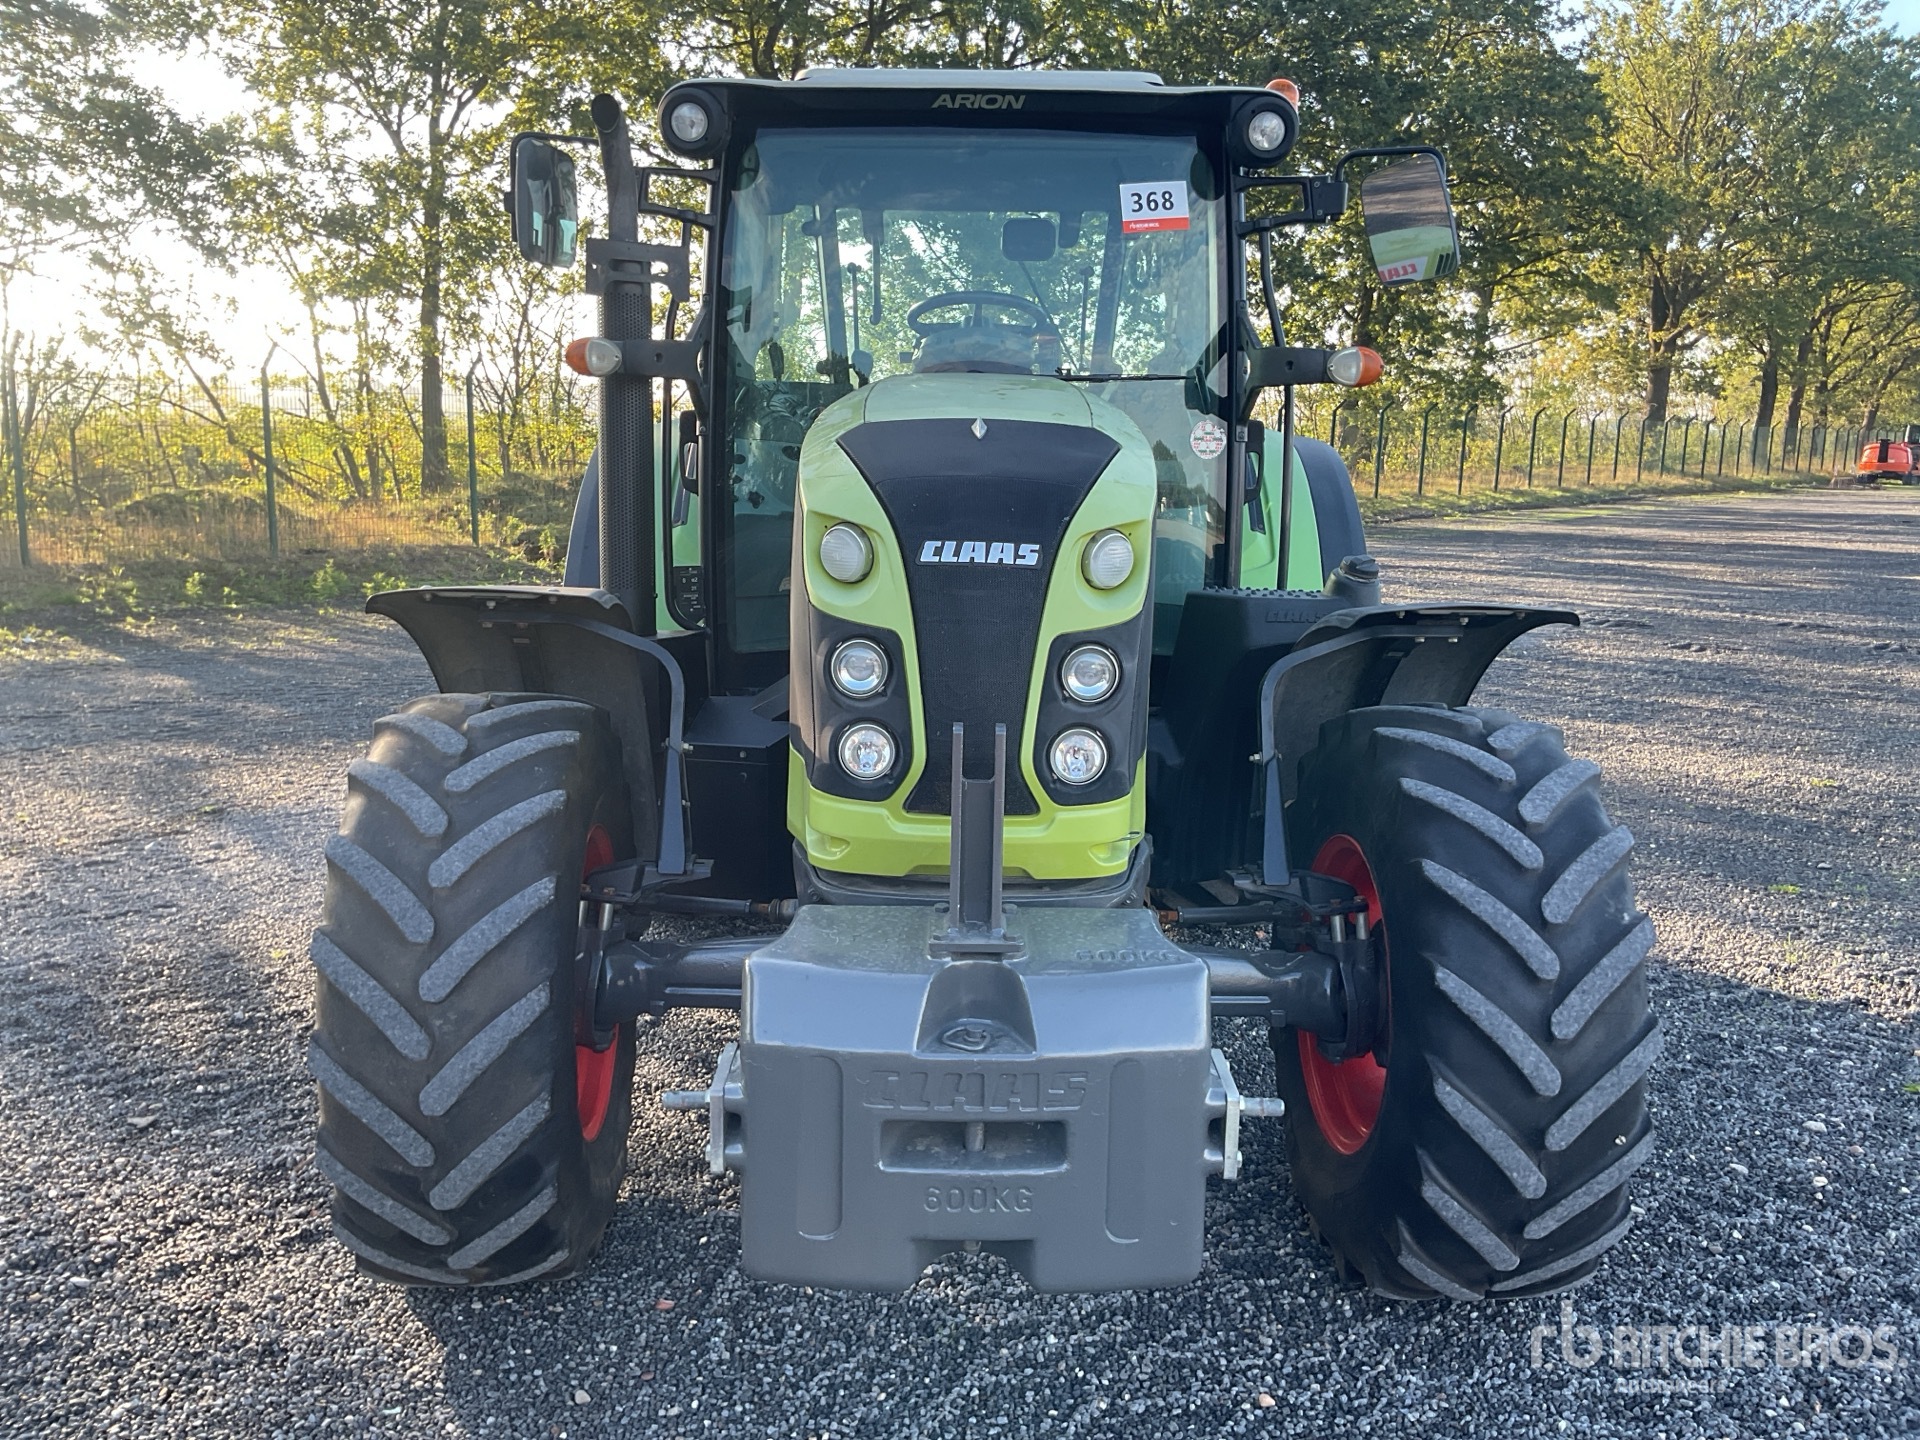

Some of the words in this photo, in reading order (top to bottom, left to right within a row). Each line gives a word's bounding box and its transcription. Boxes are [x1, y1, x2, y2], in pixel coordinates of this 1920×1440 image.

[930, 93, 1026, 109] ARION
[1130, 190, 1174, 213] 368
[920, 540, 1040, 566] CLAAS
[862, 1070, 1089, 1112] CLAAS
[923, 1185, 1034, 1213] 600KG
